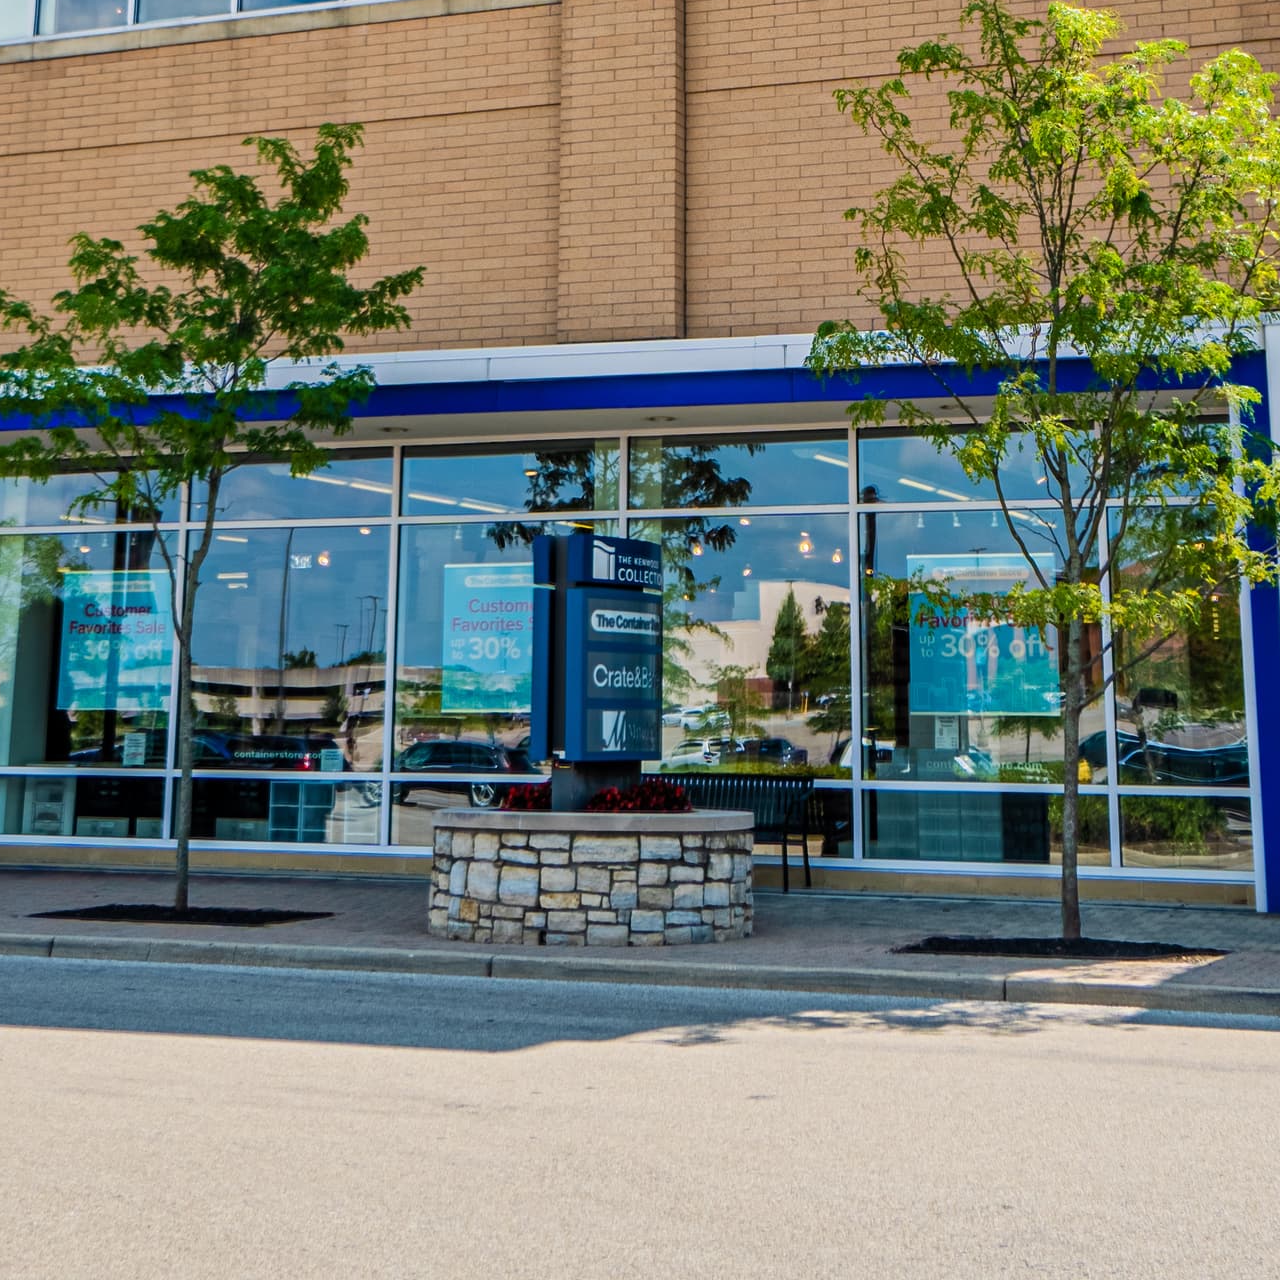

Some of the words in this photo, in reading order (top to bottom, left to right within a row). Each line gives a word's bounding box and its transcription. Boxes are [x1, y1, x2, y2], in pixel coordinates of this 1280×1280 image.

[618, 556, 632, 566] THE
[618, 568, 663, 586] COLLECTIO
[84, 603, 153, 618] Customer
[70, 620, 132, 635] Favorites
[136, 620, 166, 635] Sale
[451, 616, 523, 632] Favorites
[470, 637, 520, 660] 30%
[920, 635, 935, 647] up
[940, 634, 1000, 659] 30%
[921, 647, 934, 658] to
